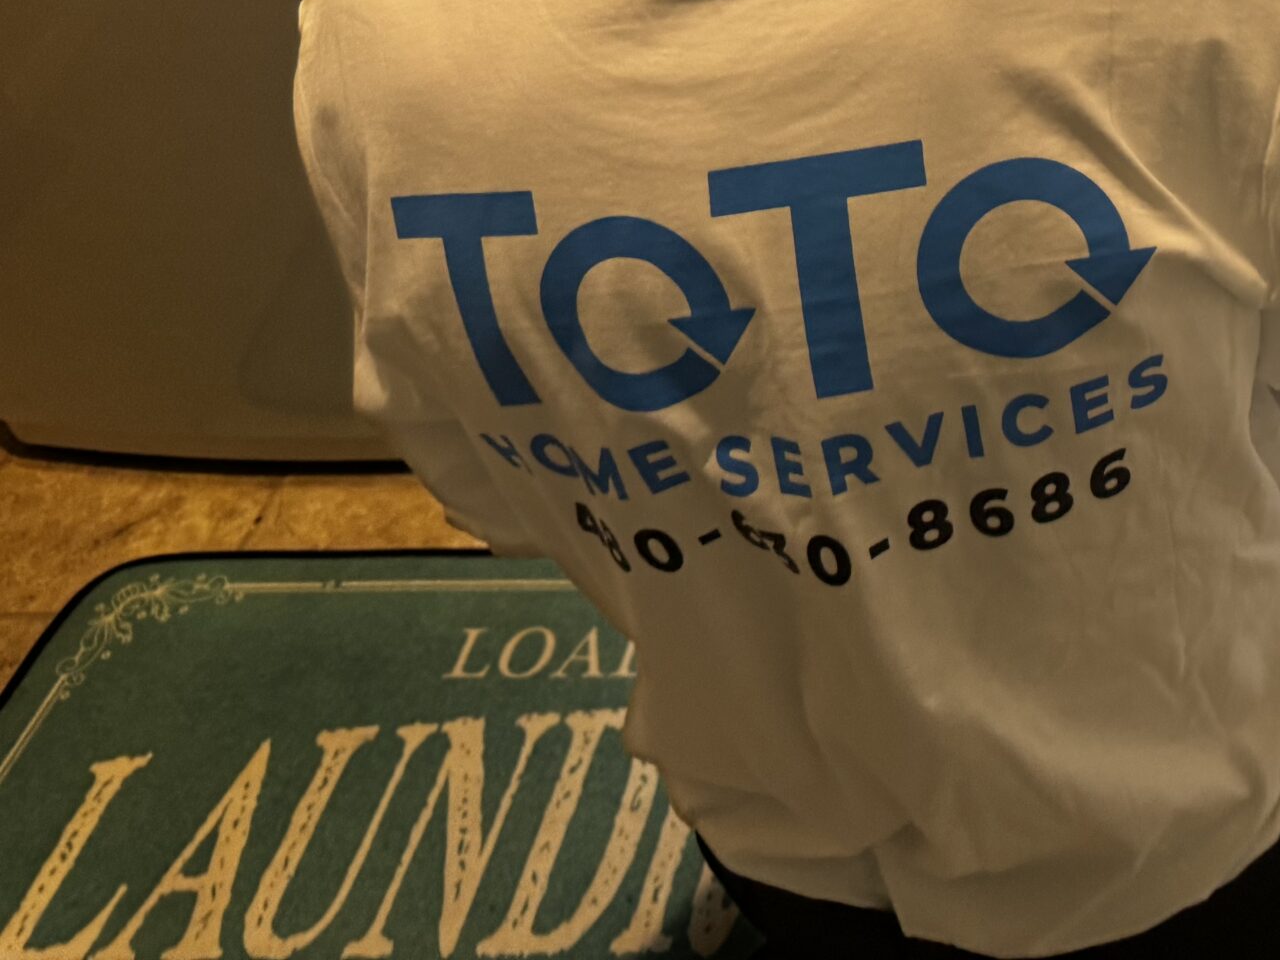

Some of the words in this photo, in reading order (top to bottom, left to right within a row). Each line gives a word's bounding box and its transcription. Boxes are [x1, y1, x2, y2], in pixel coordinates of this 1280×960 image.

[390, 140, 1158, 412] TOTO
[479, 432, 691, 502] HOME
[715, 354, 1169, 499] SERVICES
